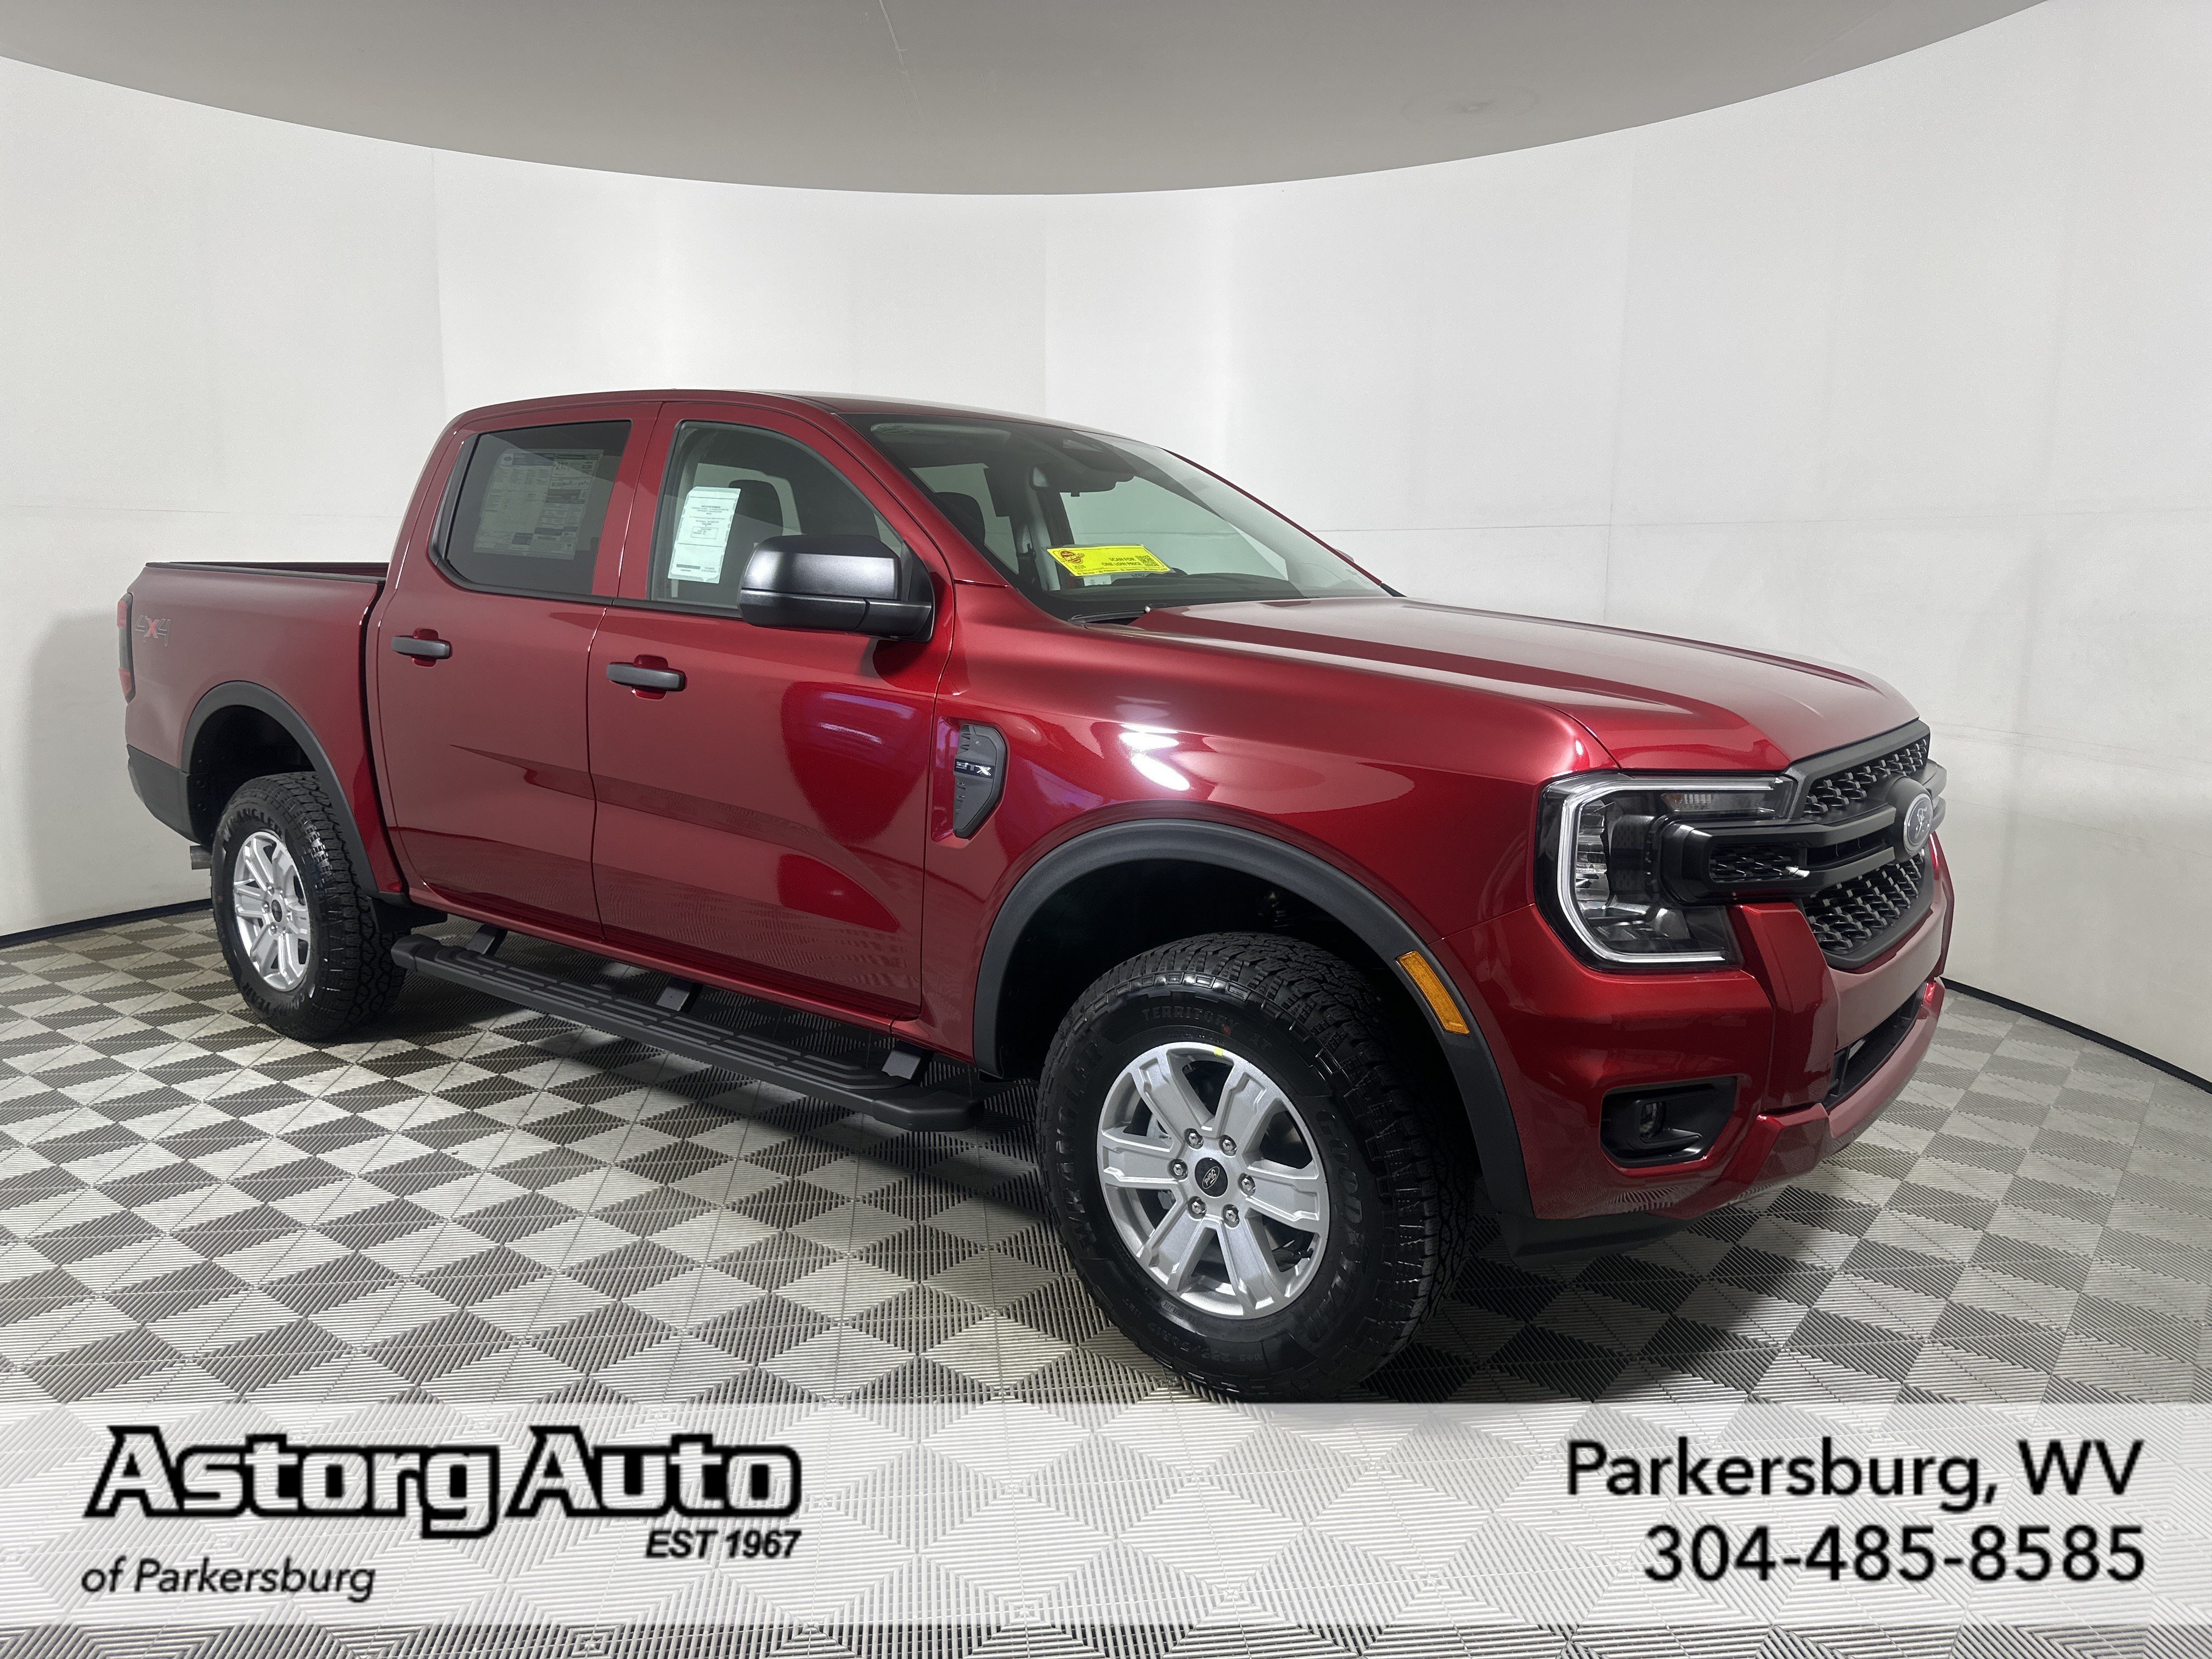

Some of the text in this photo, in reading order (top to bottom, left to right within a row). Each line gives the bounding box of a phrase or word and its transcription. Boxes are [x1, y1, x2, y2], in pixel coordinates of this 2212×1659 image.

[956, 761, 992, 777] STX
[1142, 1006, 1239, 1031] TERRITORY
[1204, 1168, 1217, 1187] Ford
[1306, 1109, 1368, 1343] GOODYEAR
